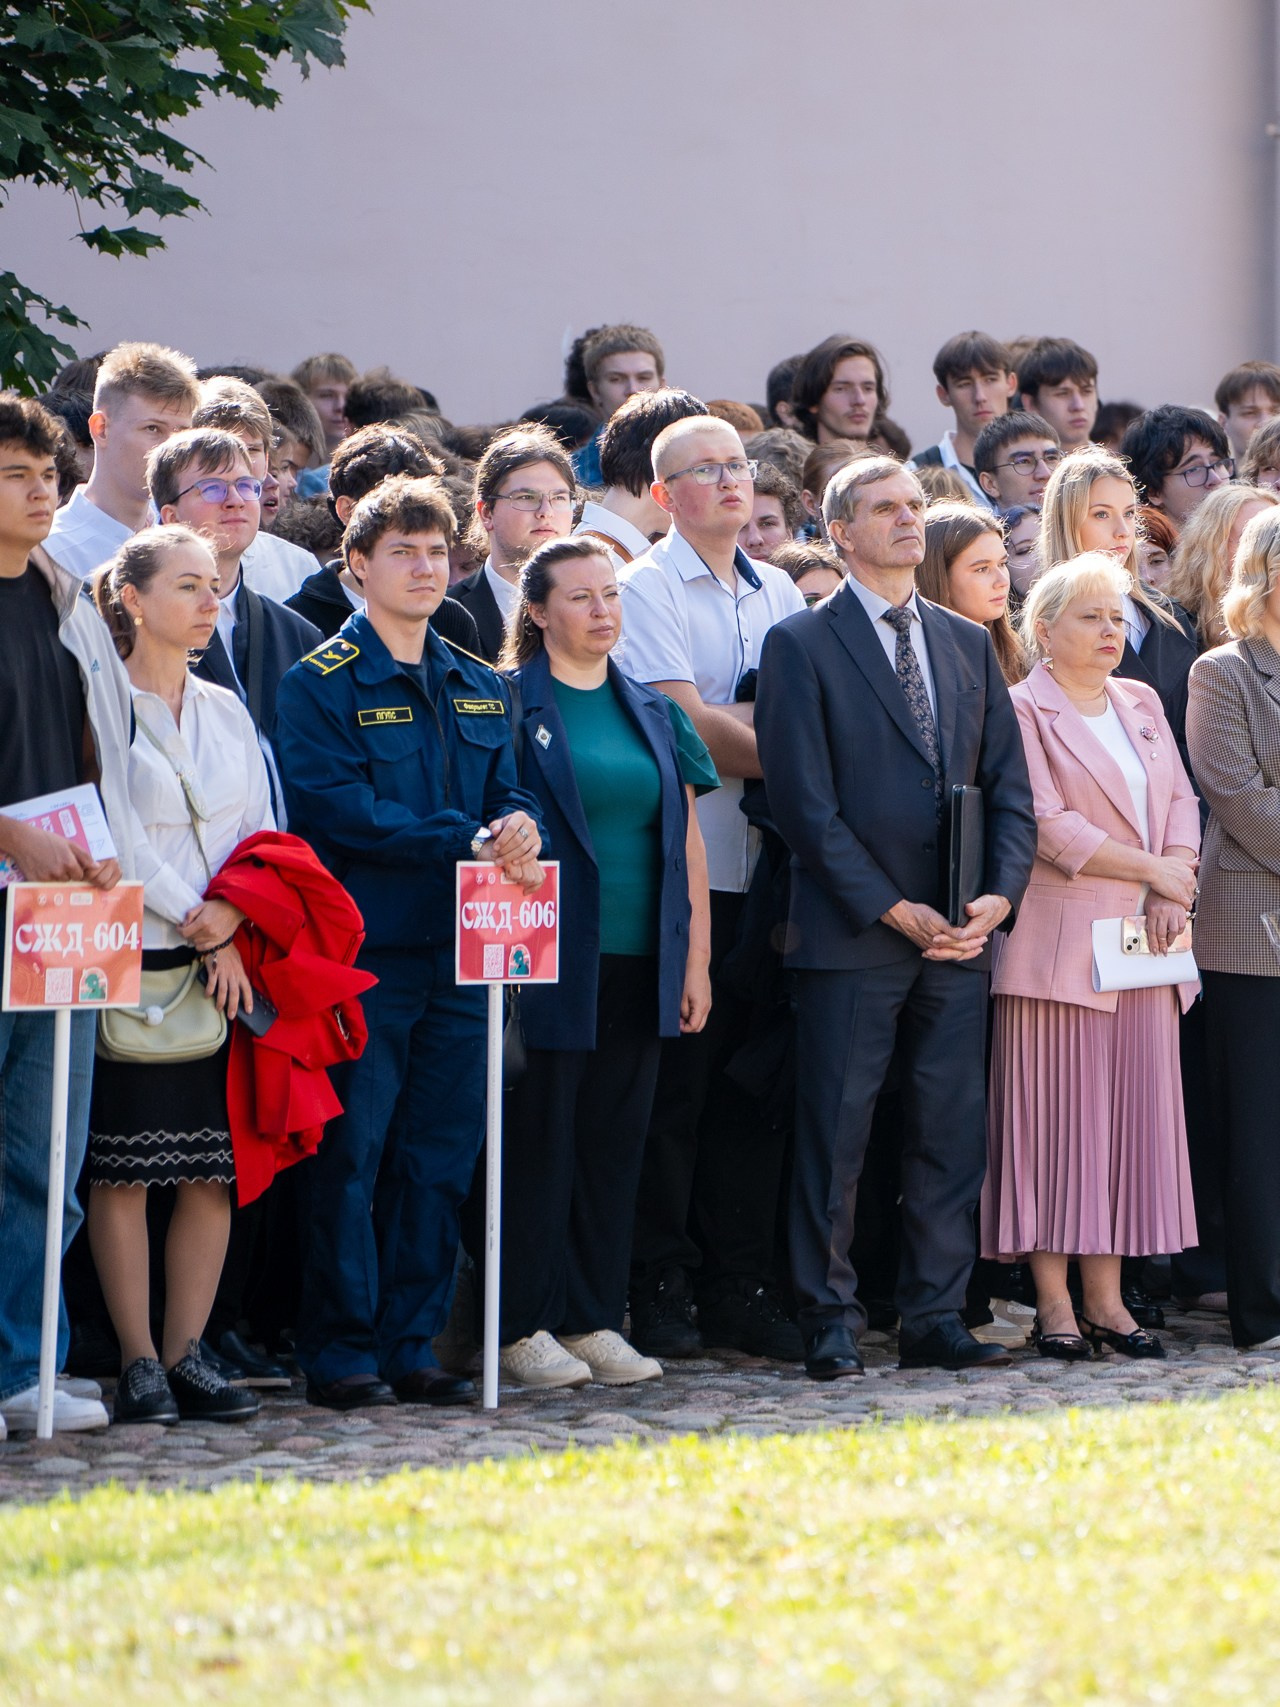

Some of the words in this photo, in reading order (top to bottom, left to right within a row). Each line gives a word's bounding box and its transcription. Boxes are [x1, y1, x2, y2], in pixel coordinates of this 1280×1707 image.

[376, 711, 397, 721] ПГУПС
[461, 900, 556, 936] СЖД-606
[14, 921, 140, 959] СЖД-604
